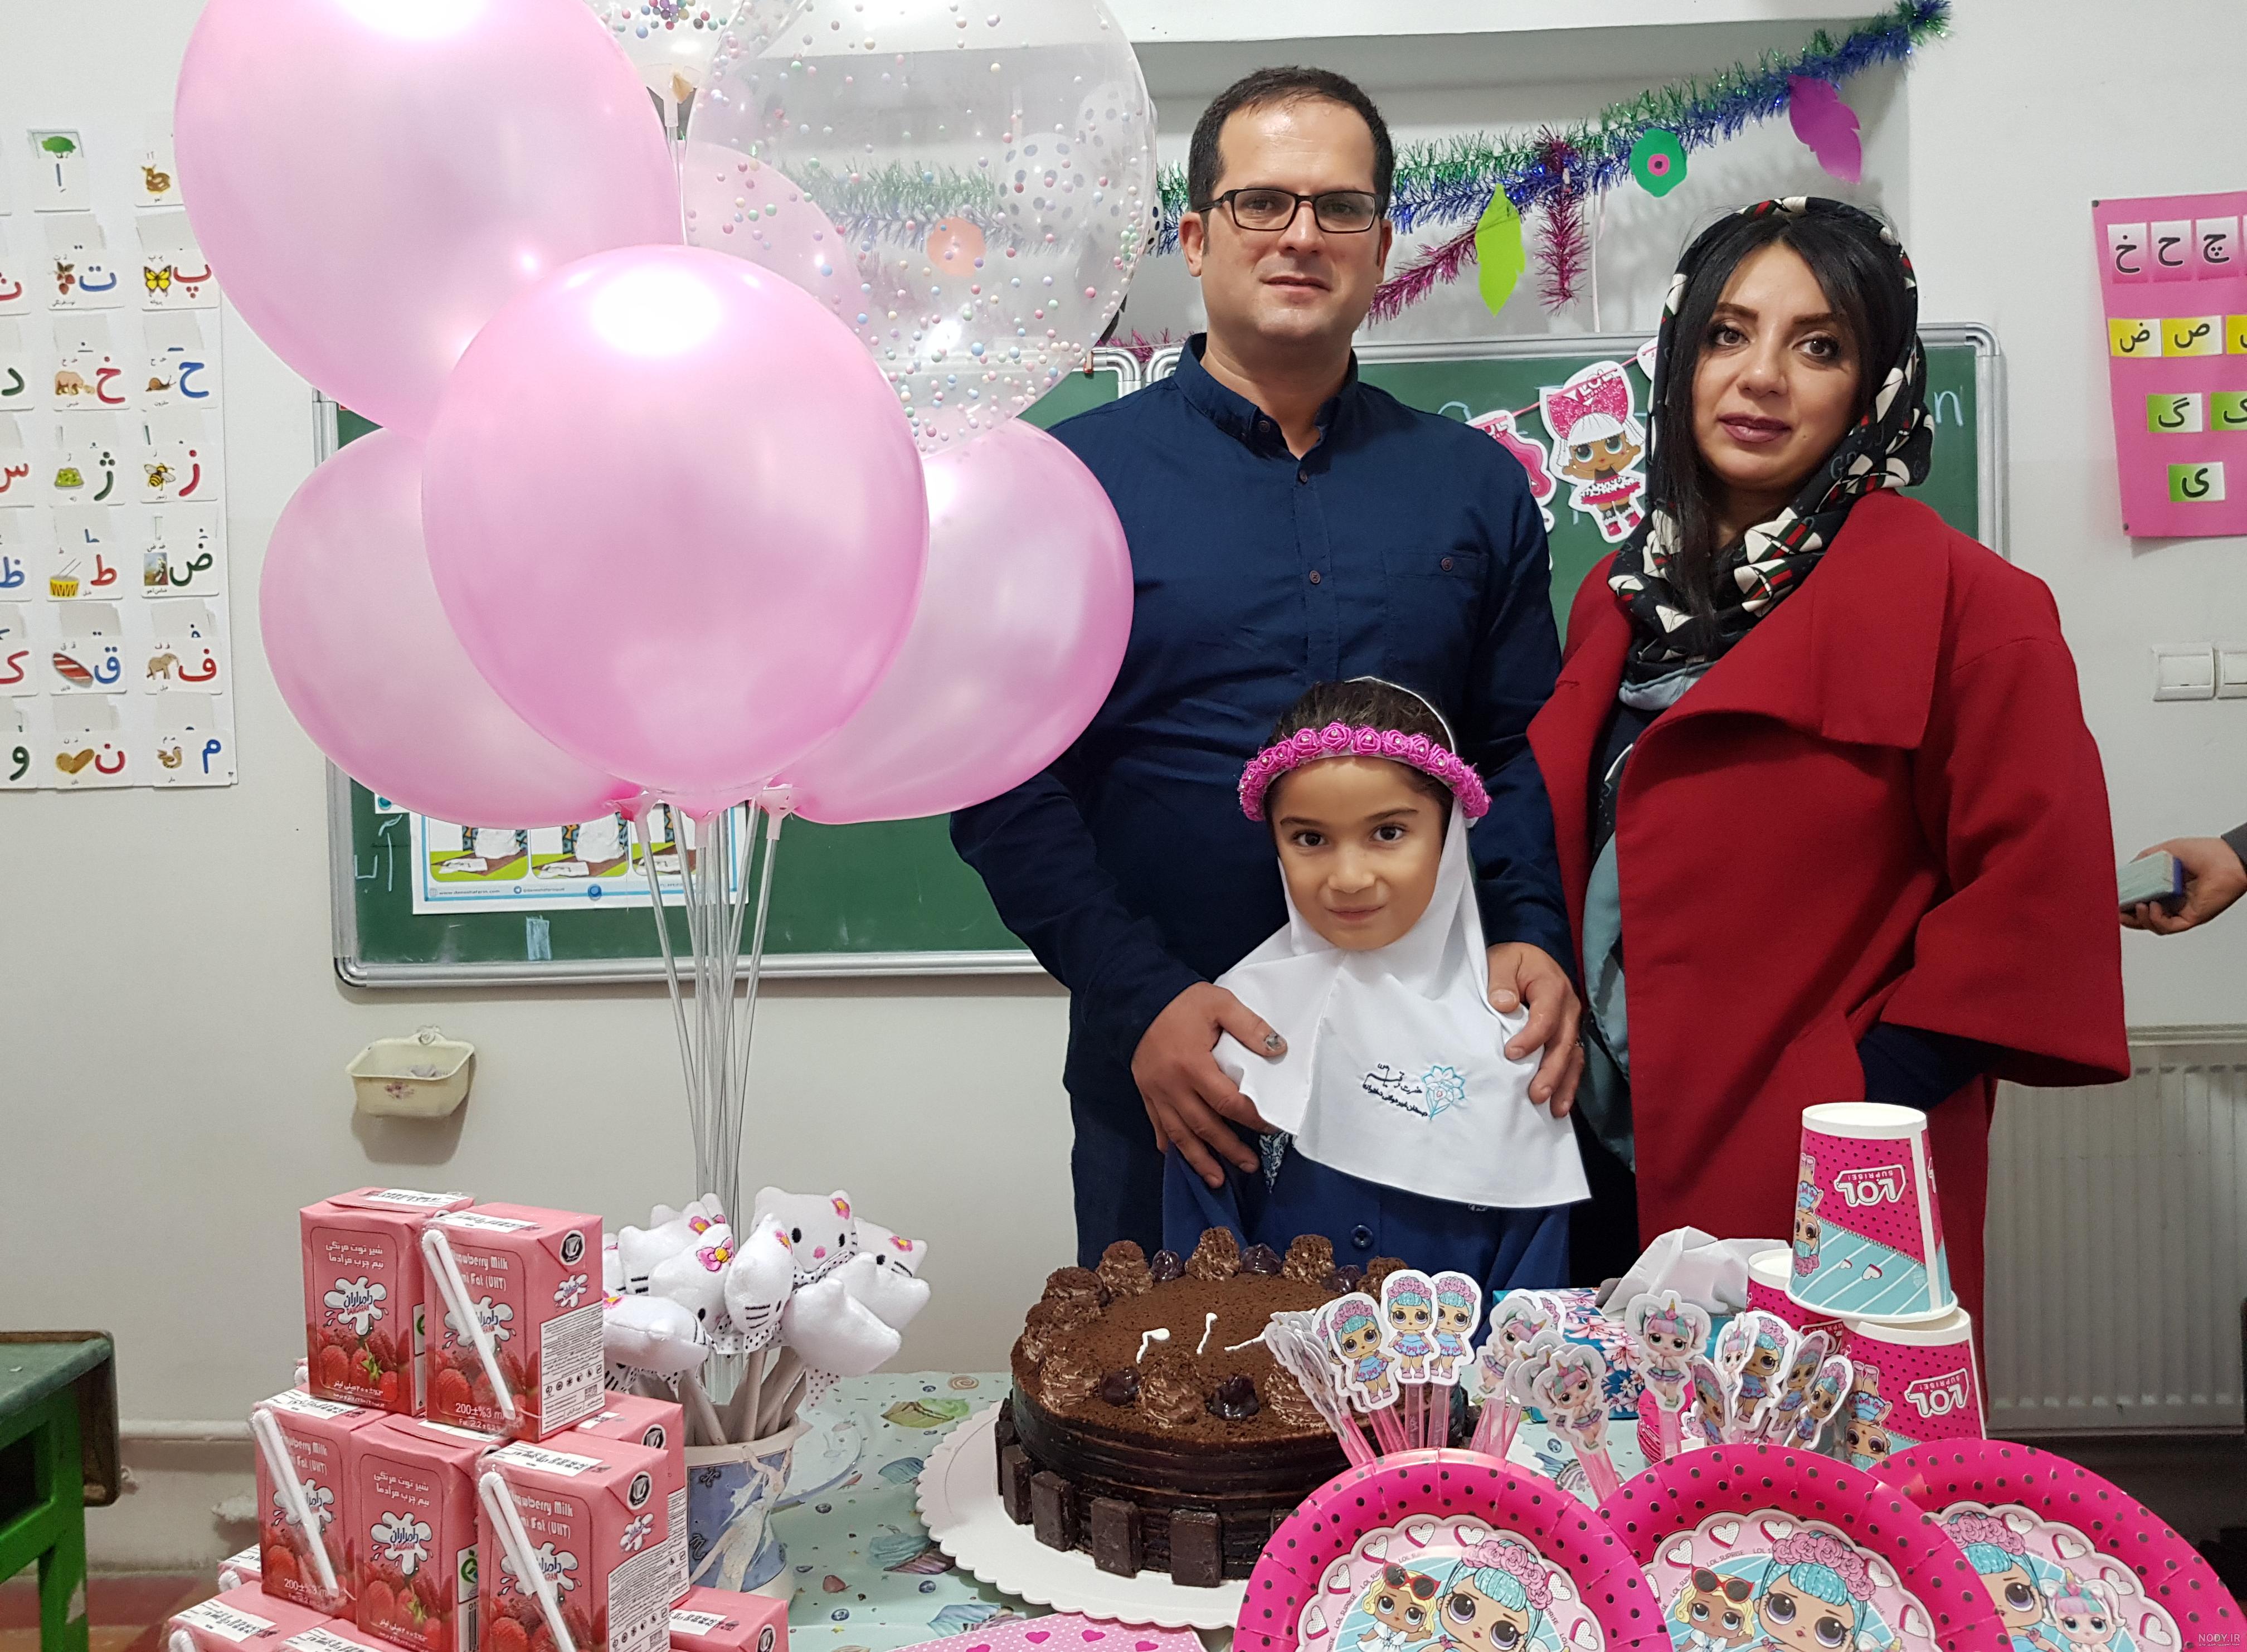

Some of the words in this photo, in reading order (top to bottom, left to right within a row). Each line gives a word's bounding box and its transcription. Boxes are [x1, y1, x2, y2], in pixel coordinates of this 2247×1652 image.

[2114, 234, 2141, 274] خ
[2157, 236, 2183, 267] ح
[2202, 233, 2230, 263] چ
[79, 265, 117, 292] ت
[173, 264, 212, 299] پ
[2119, 322, 2151, 353] ض
[2173, 322, 2211, 349] ص
[1, 367, 25, 396] د
[96, 356, 125, 404] خ
[178, 361, 210, 399] ح
[2157, 396, 2190, 428] گ
[94, 451, 116, 501] ژ
[178, 449, 201, 497] ز
[2181, 467, 2210, 498] ی
[0, 556, 26, 588] ظ
[90, 553, 117, 586] ط
[169, 542, 213, 587] ض
[94, 646, 121, 684] ق
[178, 648, 217, 682] ف
[9, 745, 30, 781] و
[95, 743, 125, 774] ن
[202, 738, 222, 774] م
[490, 1255, 508, 1270] Milk
[553, 1500, 573, 1517] Milk
